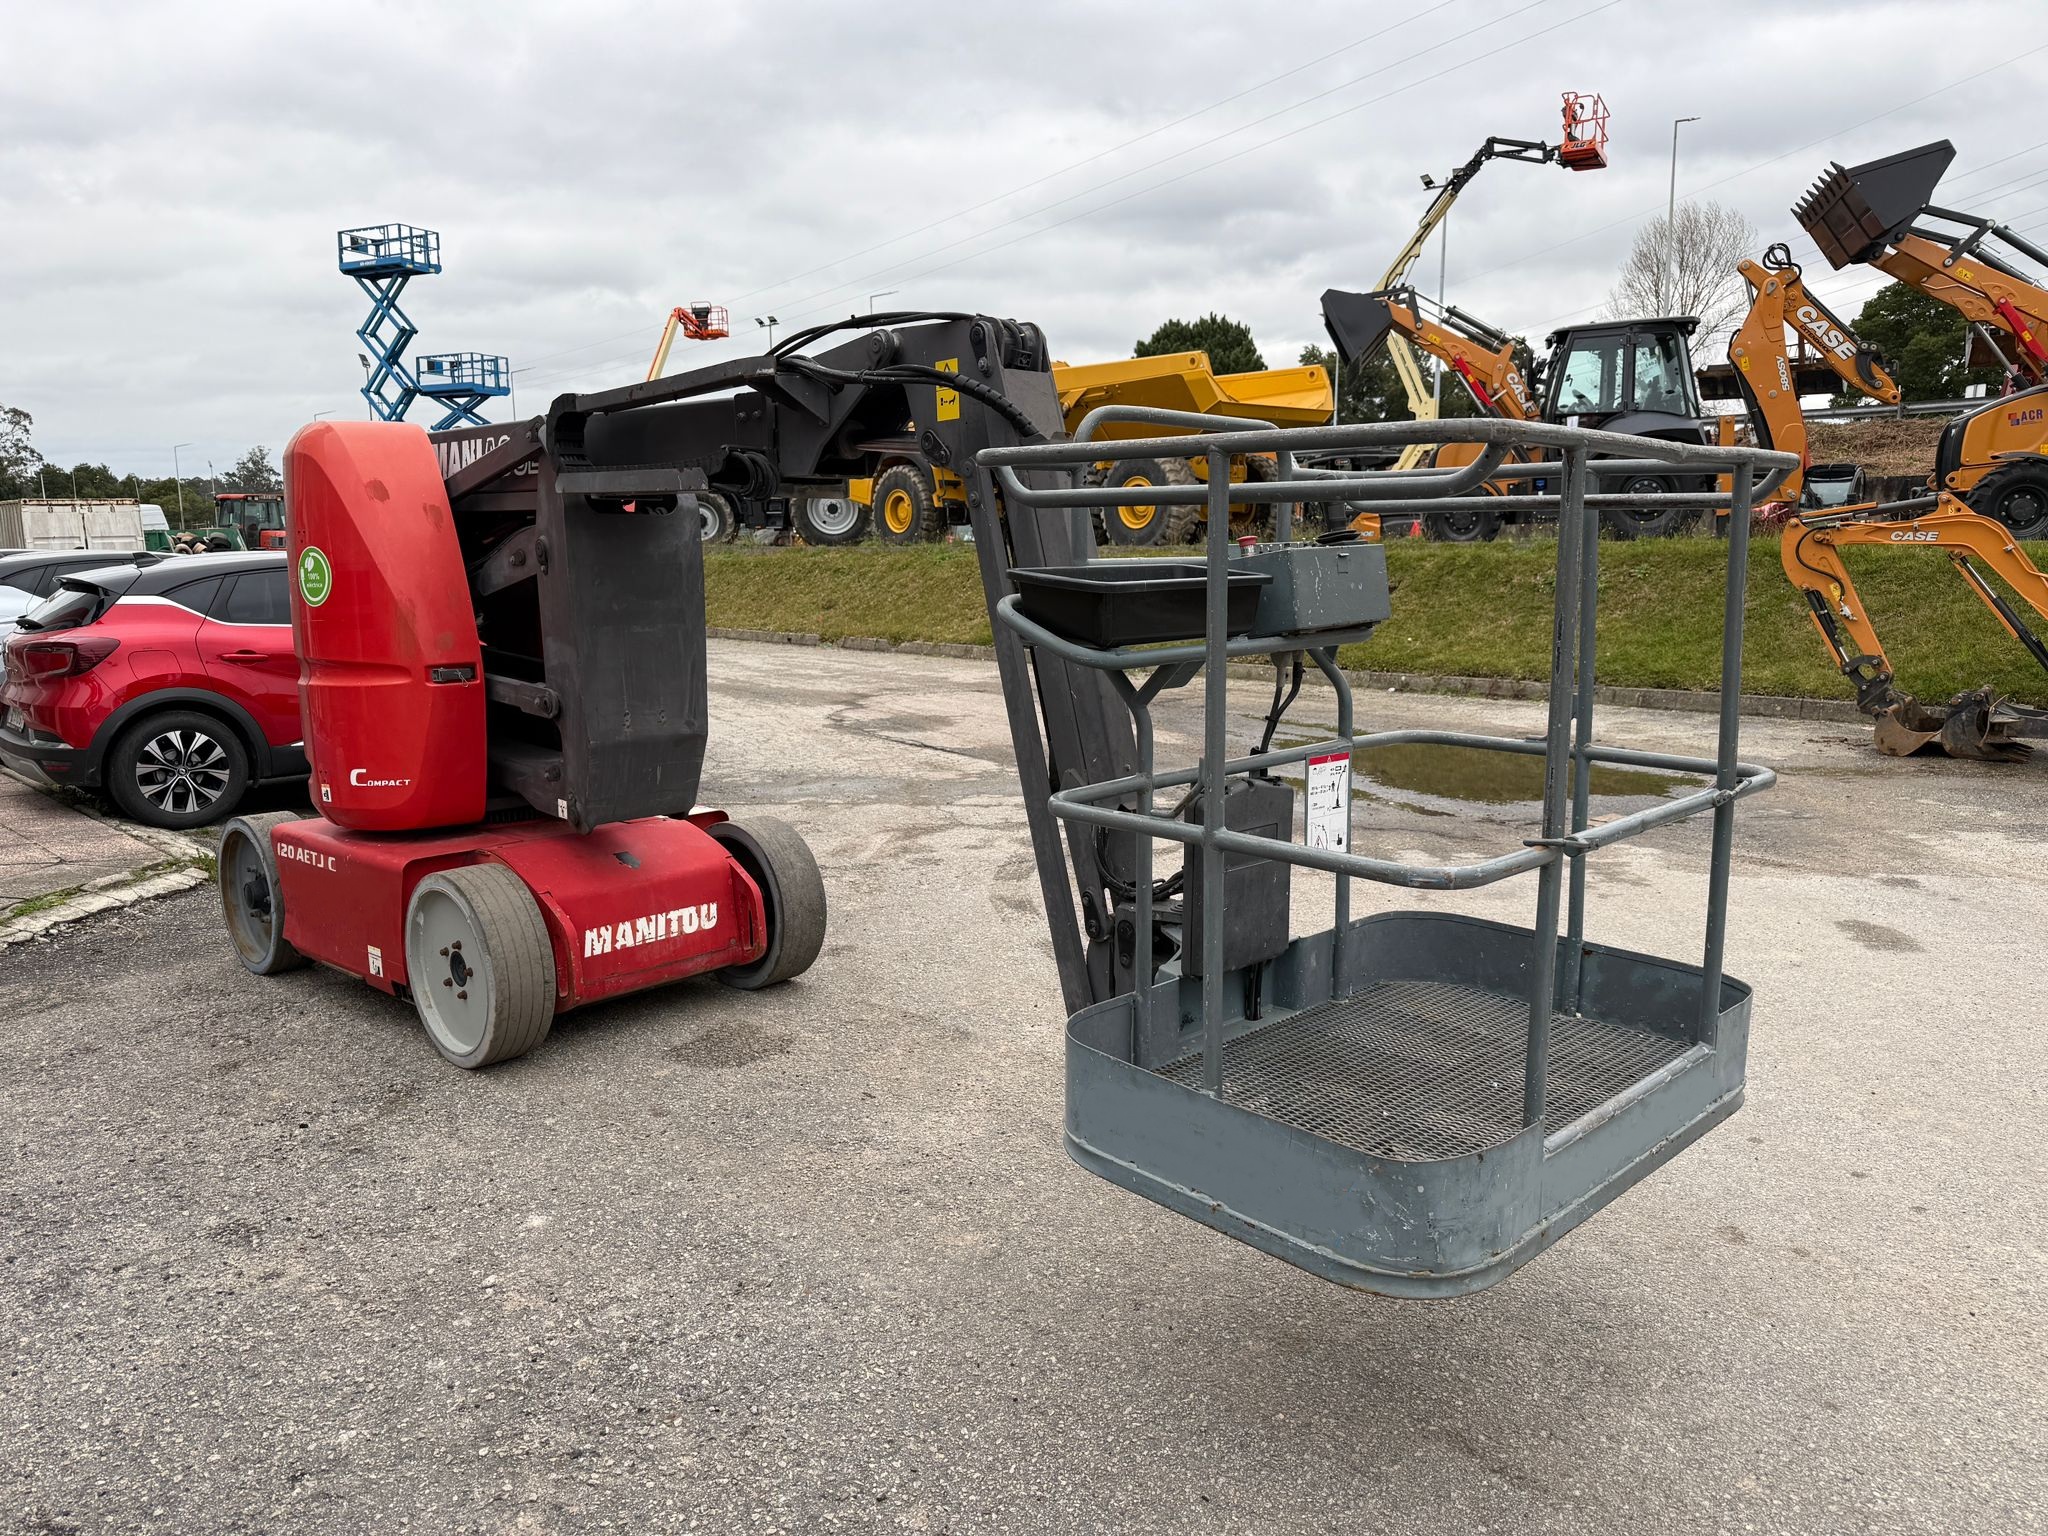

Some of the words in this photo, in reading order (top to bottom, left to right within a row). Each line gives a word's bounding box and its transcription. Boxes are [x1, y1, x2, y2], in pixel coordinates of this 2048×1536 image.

[1796, 305, 1857, 361] CASE
[1775, 355, 1790, 392] 580SV
[1506, 372, 1538, 414] CASE
[2021, 409, 2043, 421] ACR
[1890, 530, 1940, 541] CASE
[277, 842, 295, 859] 120
[296, 847, 324, 868] AETJ
[327, 856, 337, 872] C
[584, 901, 718, 958] MANITOU
